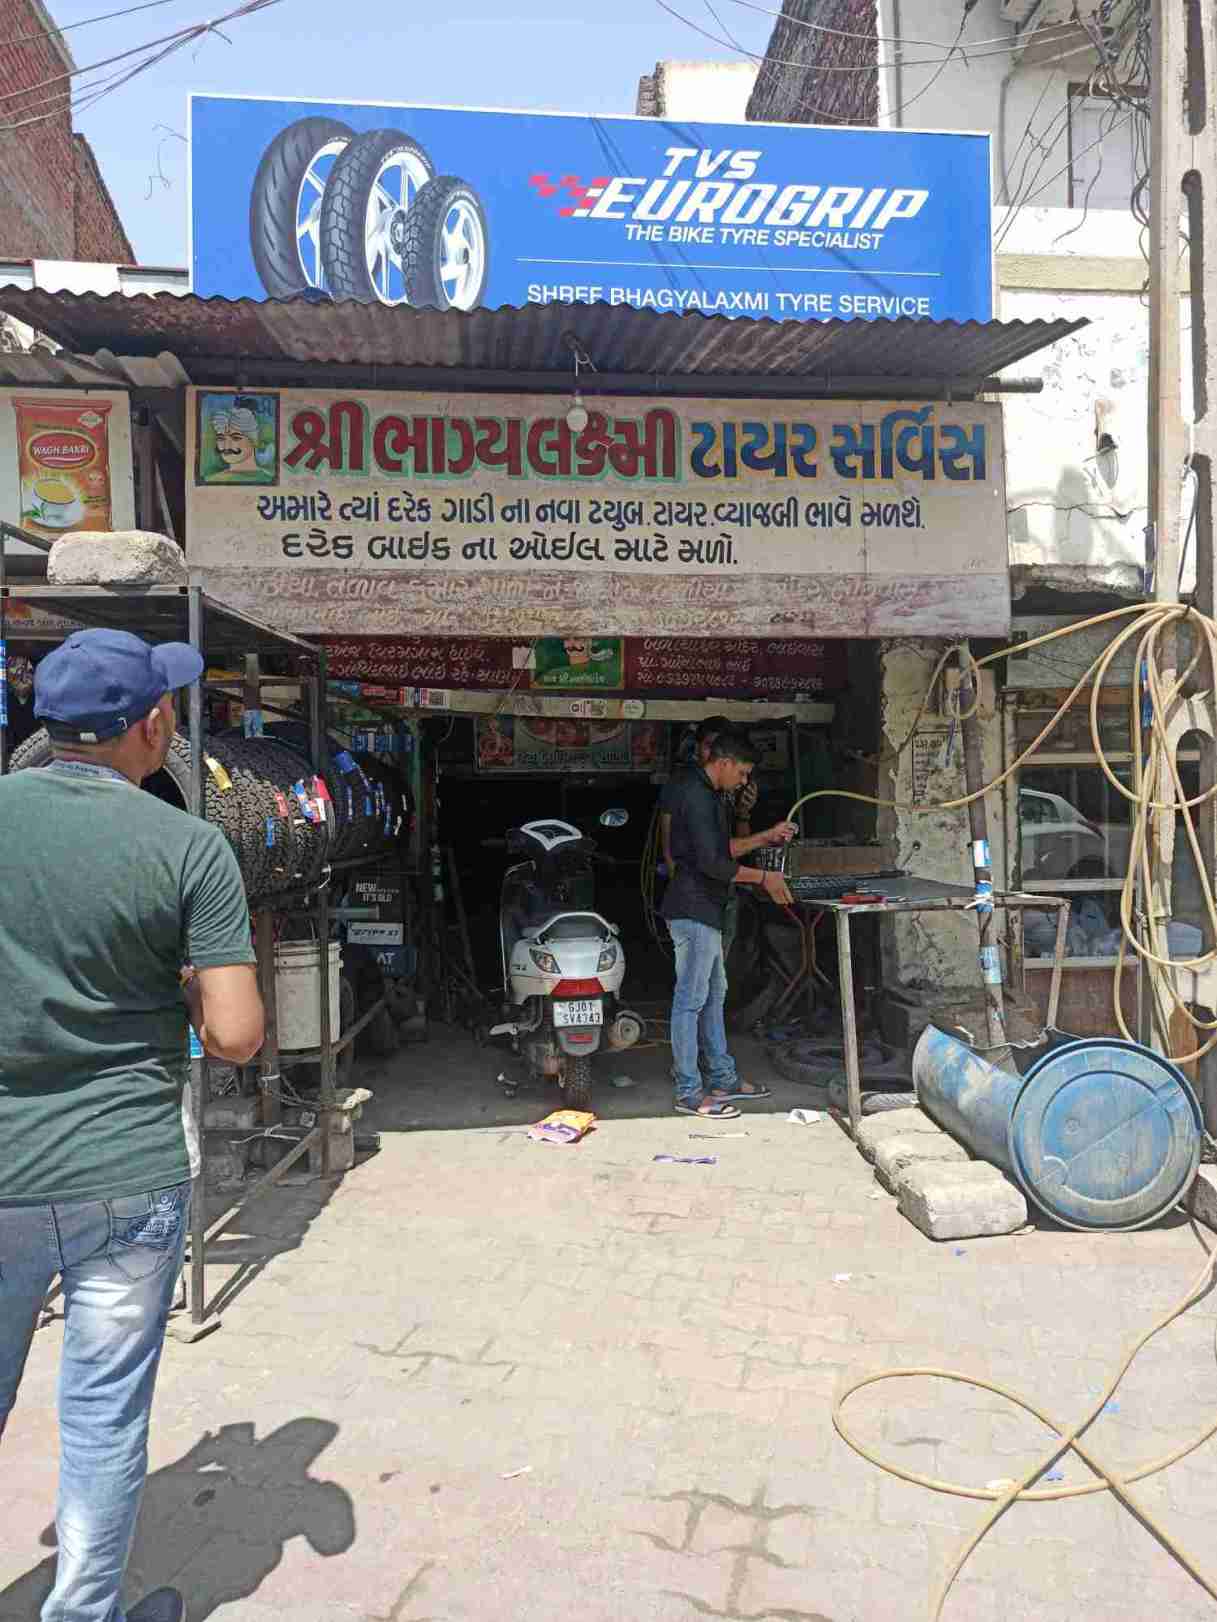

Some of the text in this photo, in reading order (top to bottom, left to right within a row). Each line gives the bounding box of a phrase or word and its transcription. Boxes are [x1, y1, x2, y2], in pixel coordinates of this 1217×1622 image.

[662, 146, 762, 181] TVS
[584, 177, 930, 230] EUROGRIP
[624, 224, 884, 251] THE BIKE TYRE SPECIALIST
[610, 287, 769, 311] BHAGYALAXMI
[776, 292, 832, 312] TYRE
[839, 295, 930, 316] SERVICE
[690, 421, 816, 478] ટાયર
[829, 405, 986, 480] સર્વિસ
[257, 490, 332, 521] અમારે
[338, 491, 380, 522] ત્યાં
[387, 490, 432, 522] દરેક
[441, 492, 495, 523] ગાડી
[500, 499, 530, 523] ના
[535, 499, 580, 523] નવા
[281, 528, 354, 559] દરેક
[462, 537, 498, 560] ના
[614, 533, 669, 562] માટે
